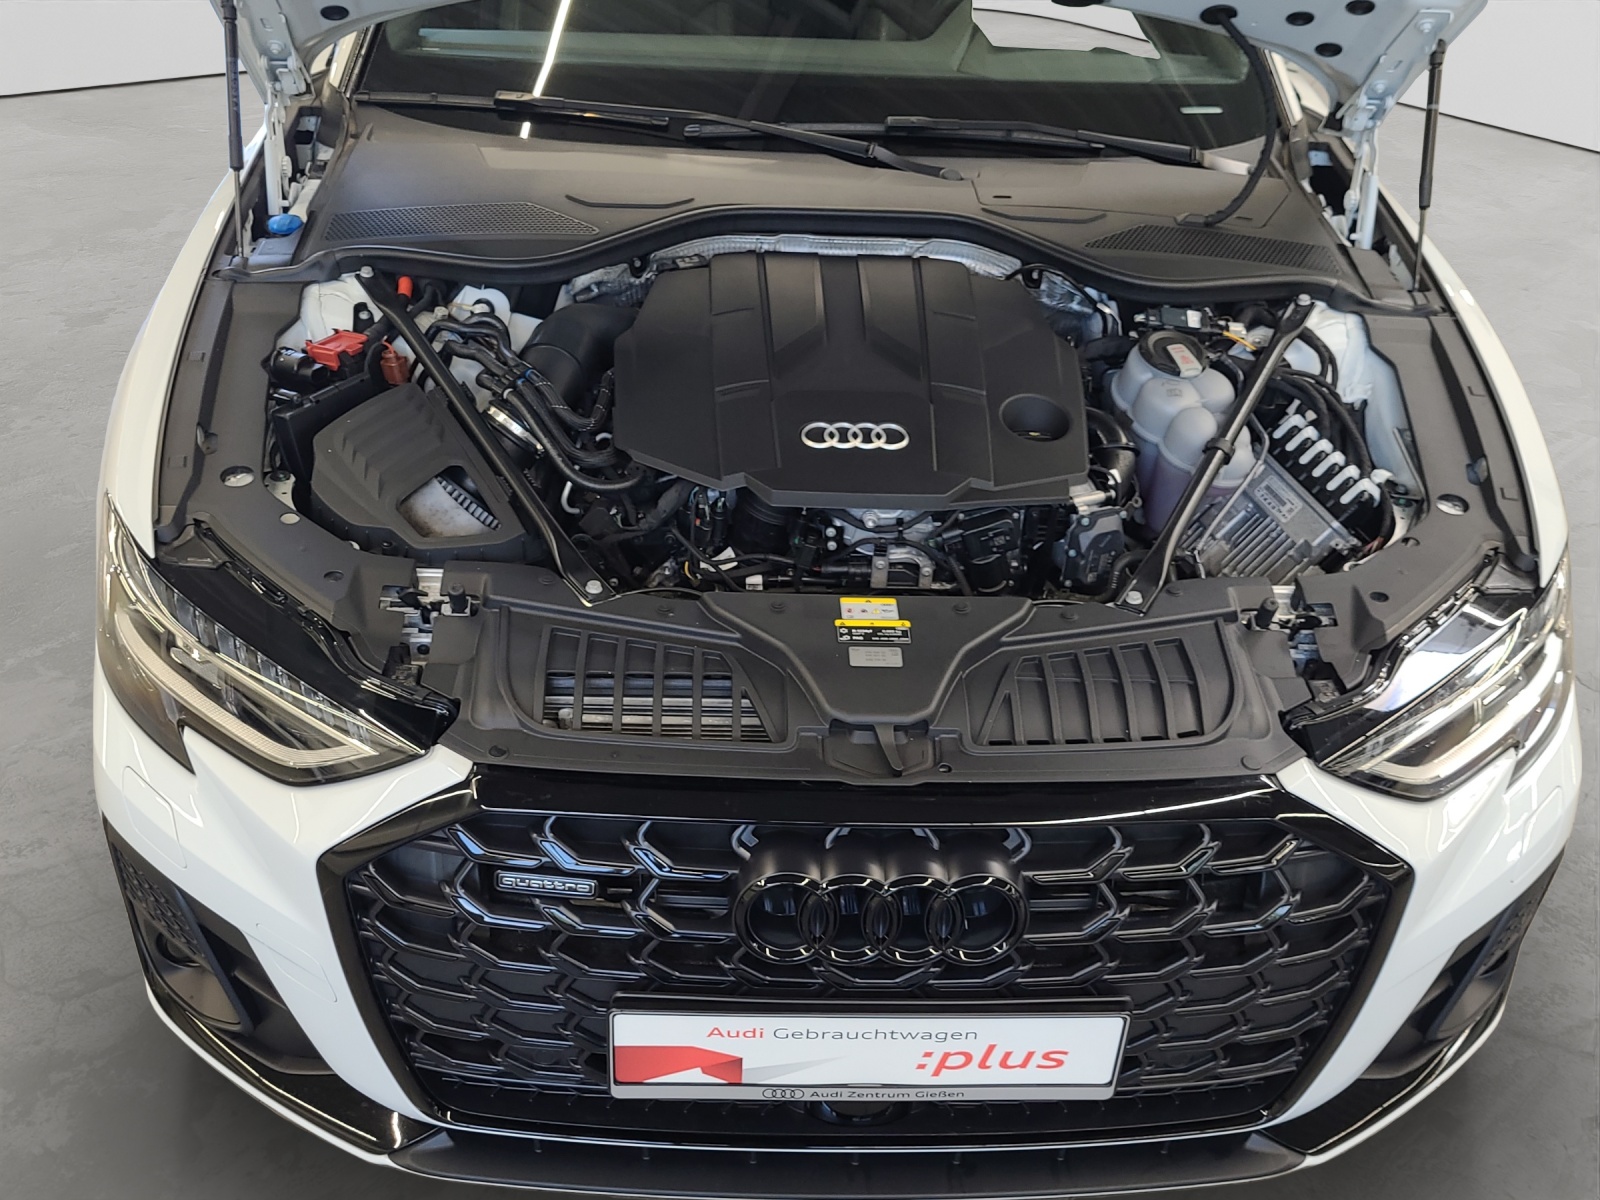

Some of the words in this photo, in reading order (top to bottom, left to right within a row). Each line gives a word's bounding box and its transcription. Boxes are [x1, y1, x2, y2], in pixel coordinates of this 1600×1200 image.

[501, 877, 590, 892] quattro
[706, 1027, 765, 1039] Audi
[773, 1028, 978, 1043] Gebrauchtwagen
[810, 1090, 843, 1098] Audi
[847, 1091, 910, 1099] Zentrum
[915, 1090, 965, 1099] Gießen
